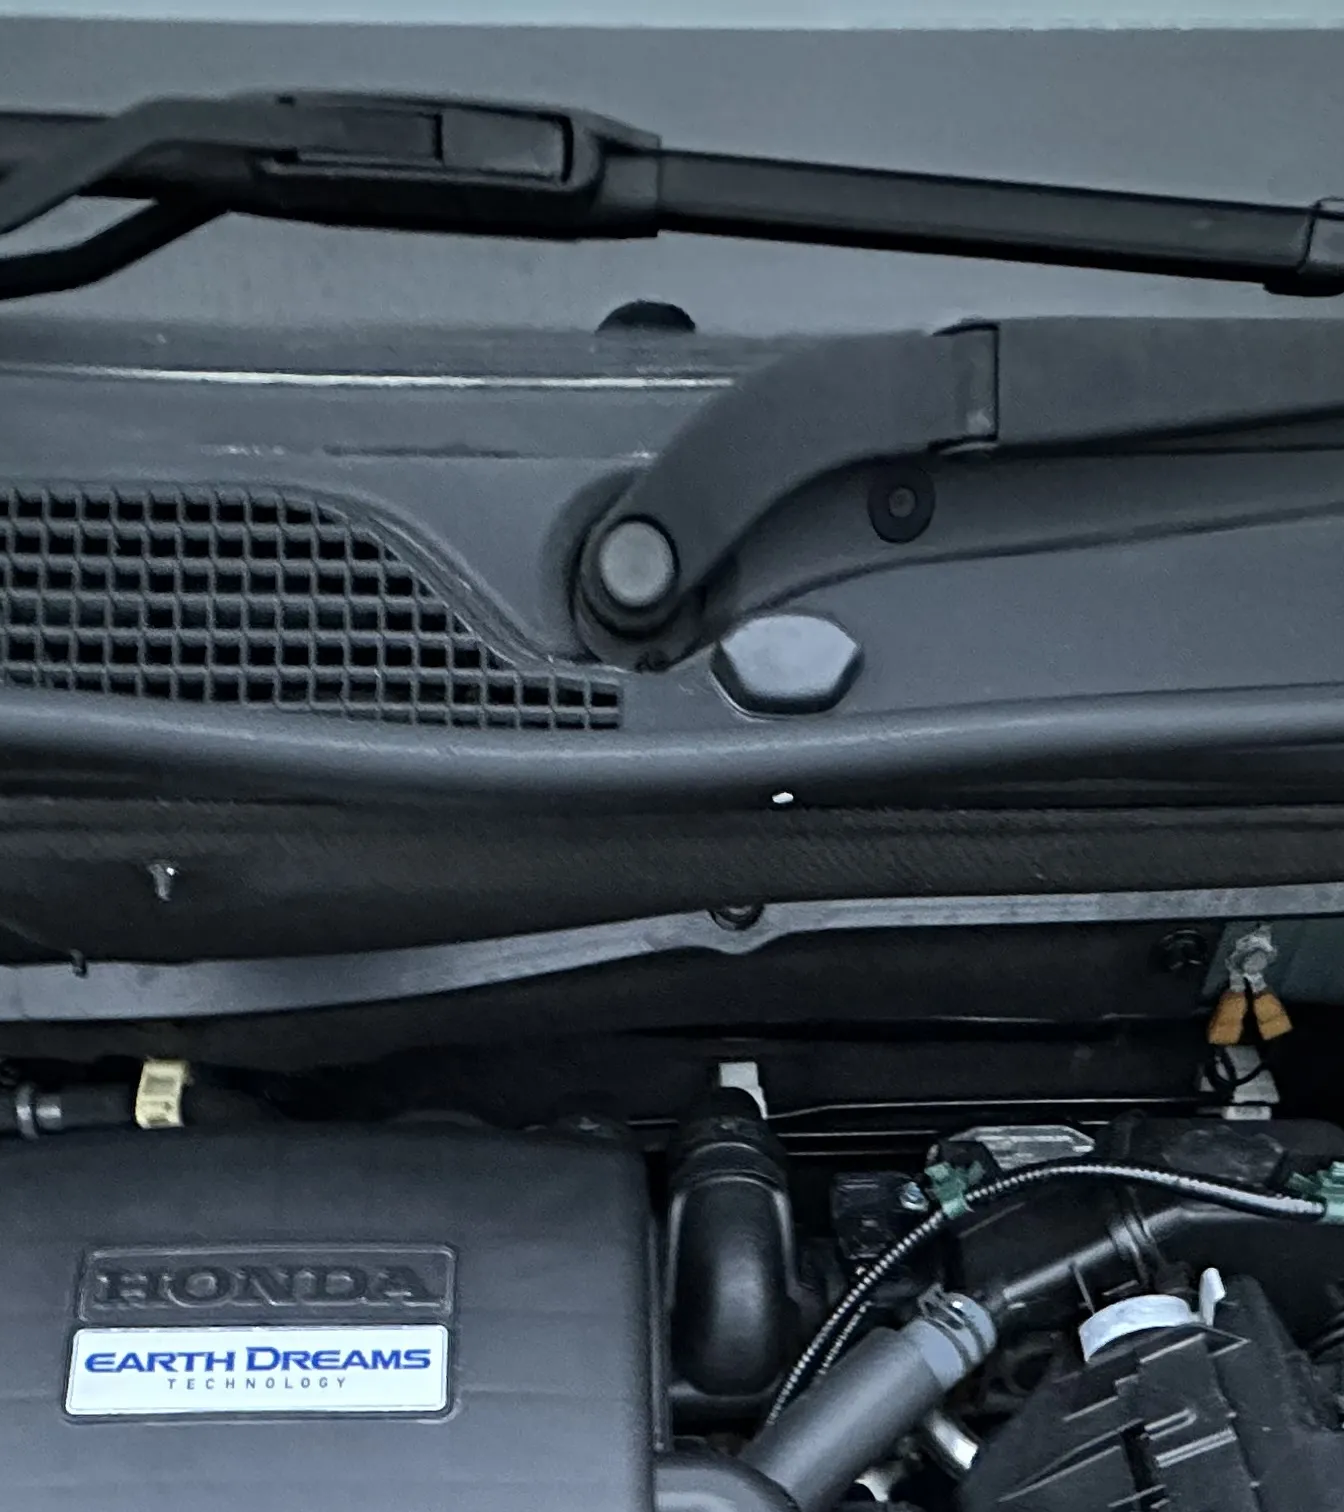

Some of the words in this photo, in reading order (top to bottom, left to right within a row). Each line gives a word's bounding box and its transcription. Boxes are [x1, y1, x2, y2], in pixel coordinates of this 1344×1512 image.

[93, 1264, 446, 1308] HONDA
[85, 1351, 237, 1374] EARTH
[245, 1346, 432, 1372] DREAMS
[167, 1376, 348, 1391] TECHNOLOGY
